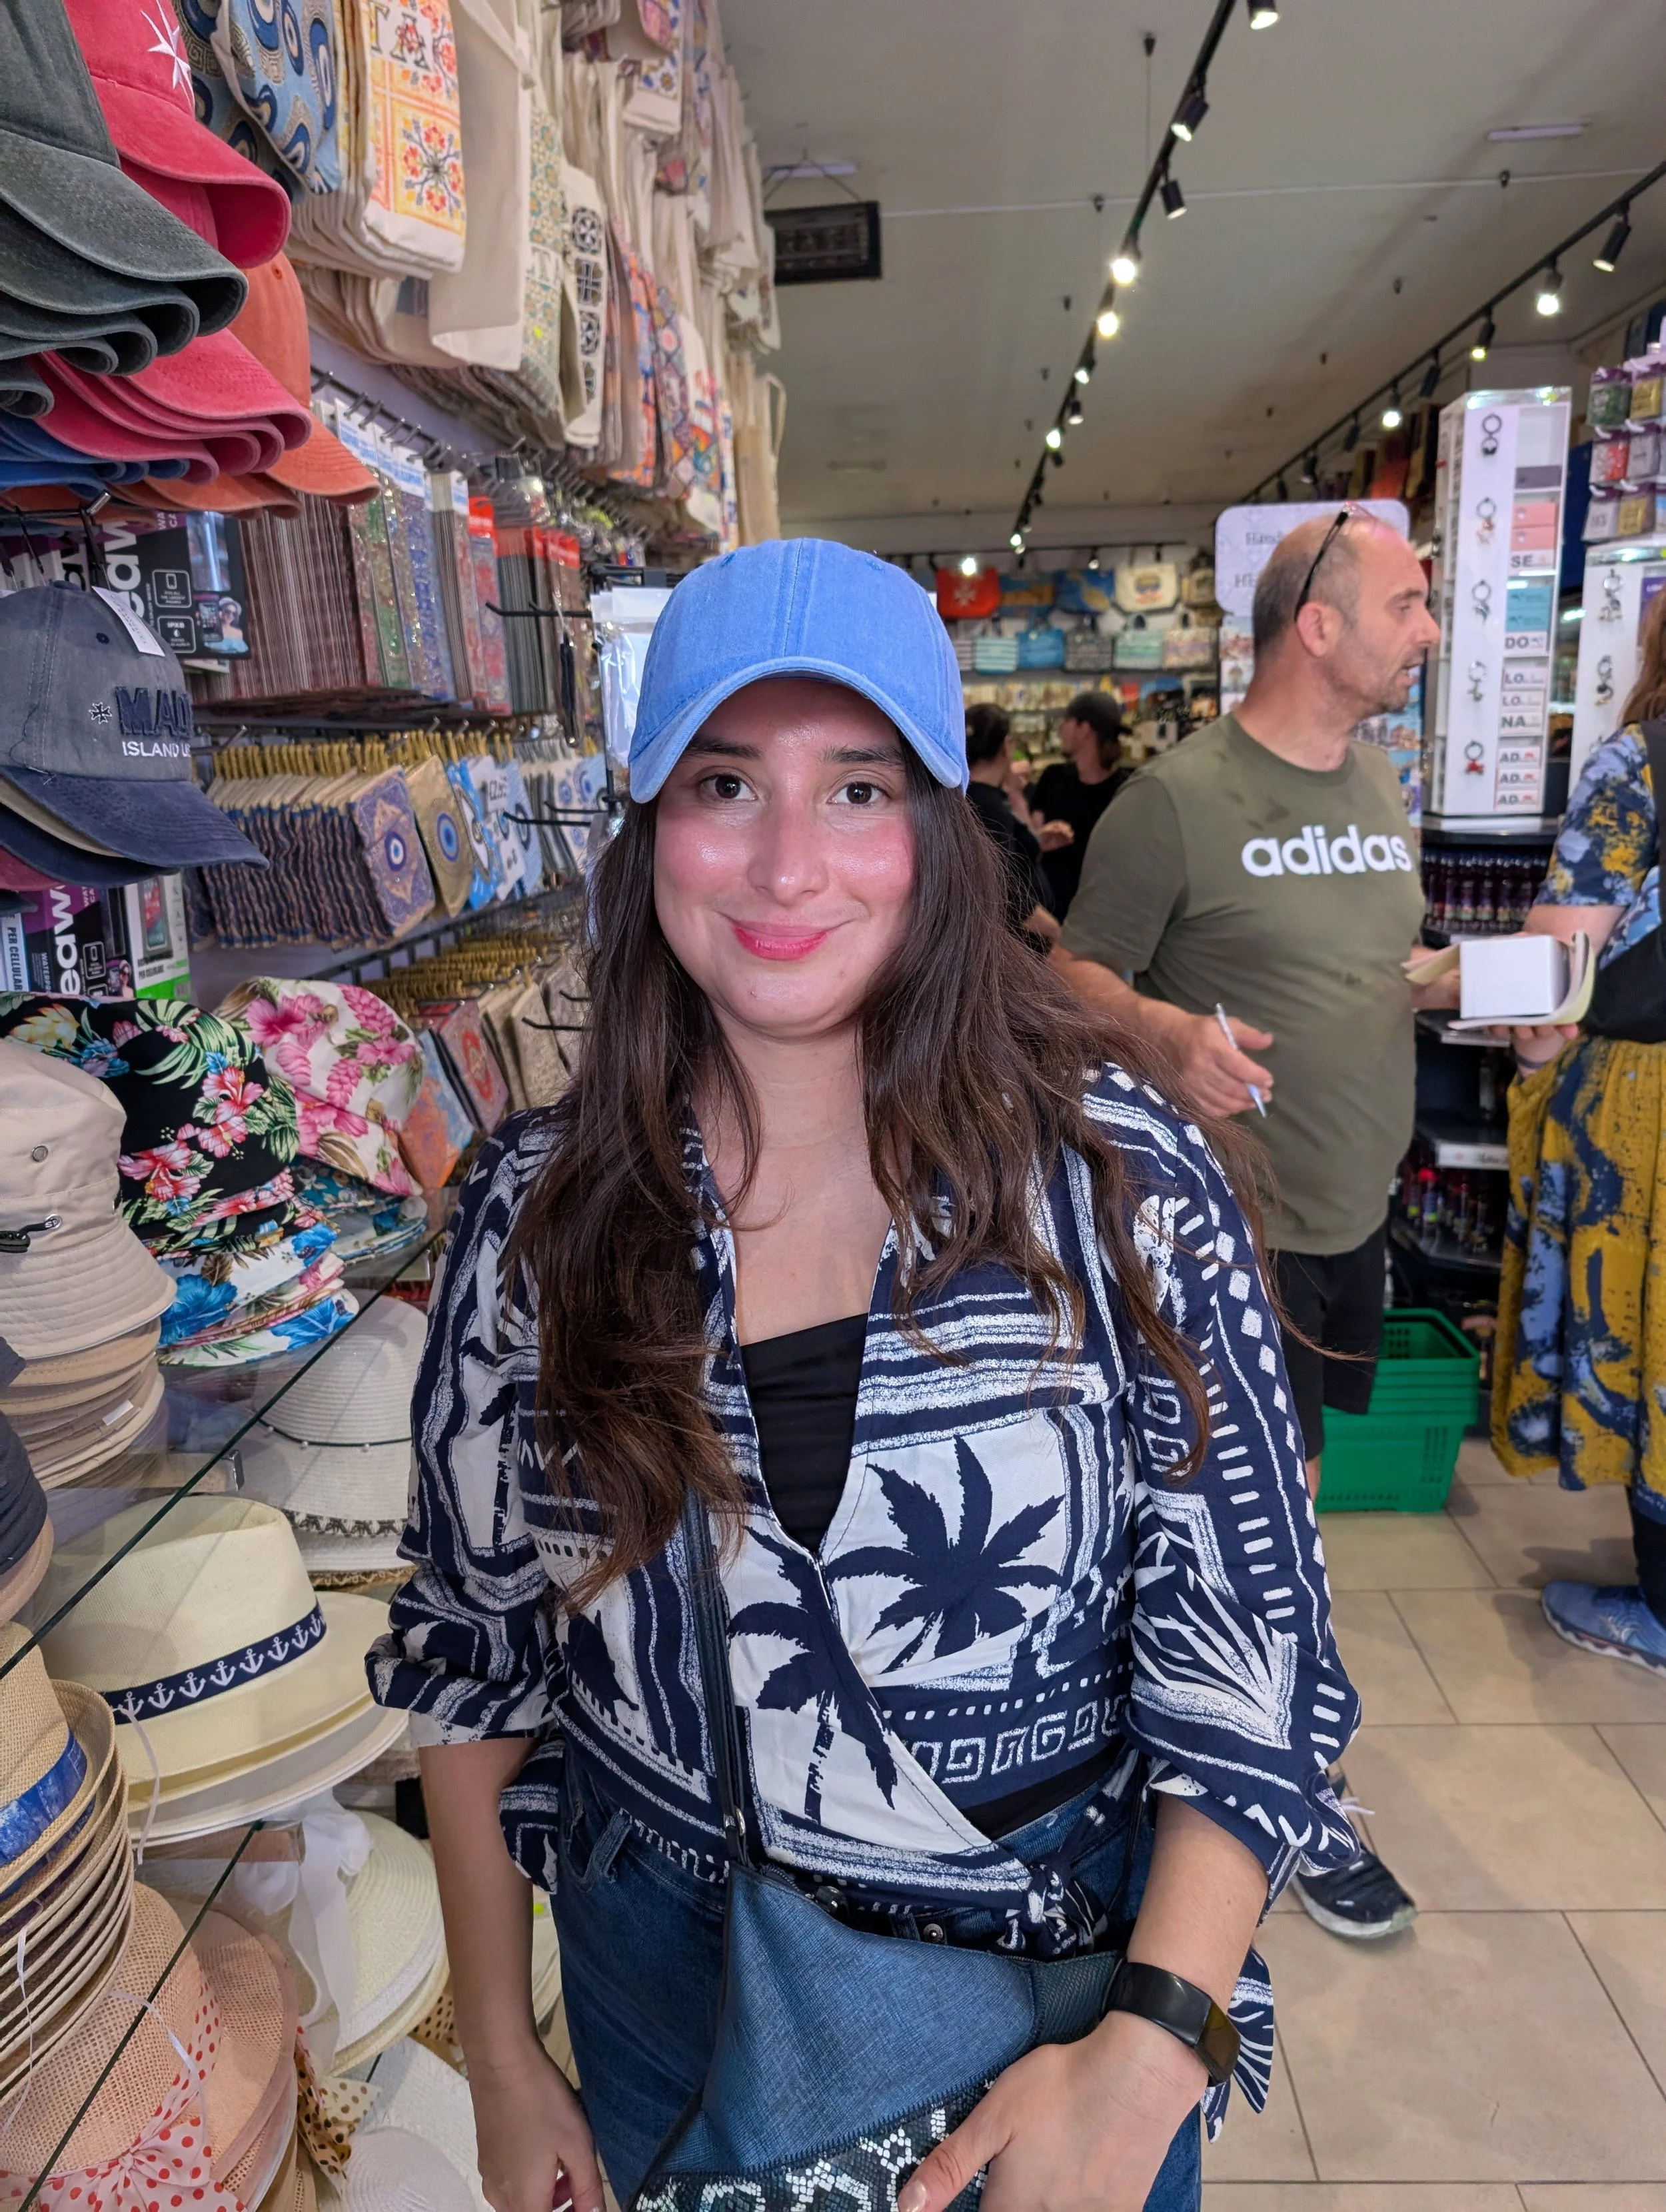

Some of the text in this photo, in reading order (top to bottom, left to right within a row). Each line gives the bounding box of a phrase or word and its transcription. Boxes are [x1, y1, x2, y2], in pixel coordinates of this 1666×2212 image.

[123, 740, 179, 758] ISLAND
[1241, 824, 1413, 877] adidas
[7, 927, 17, 944] PER
